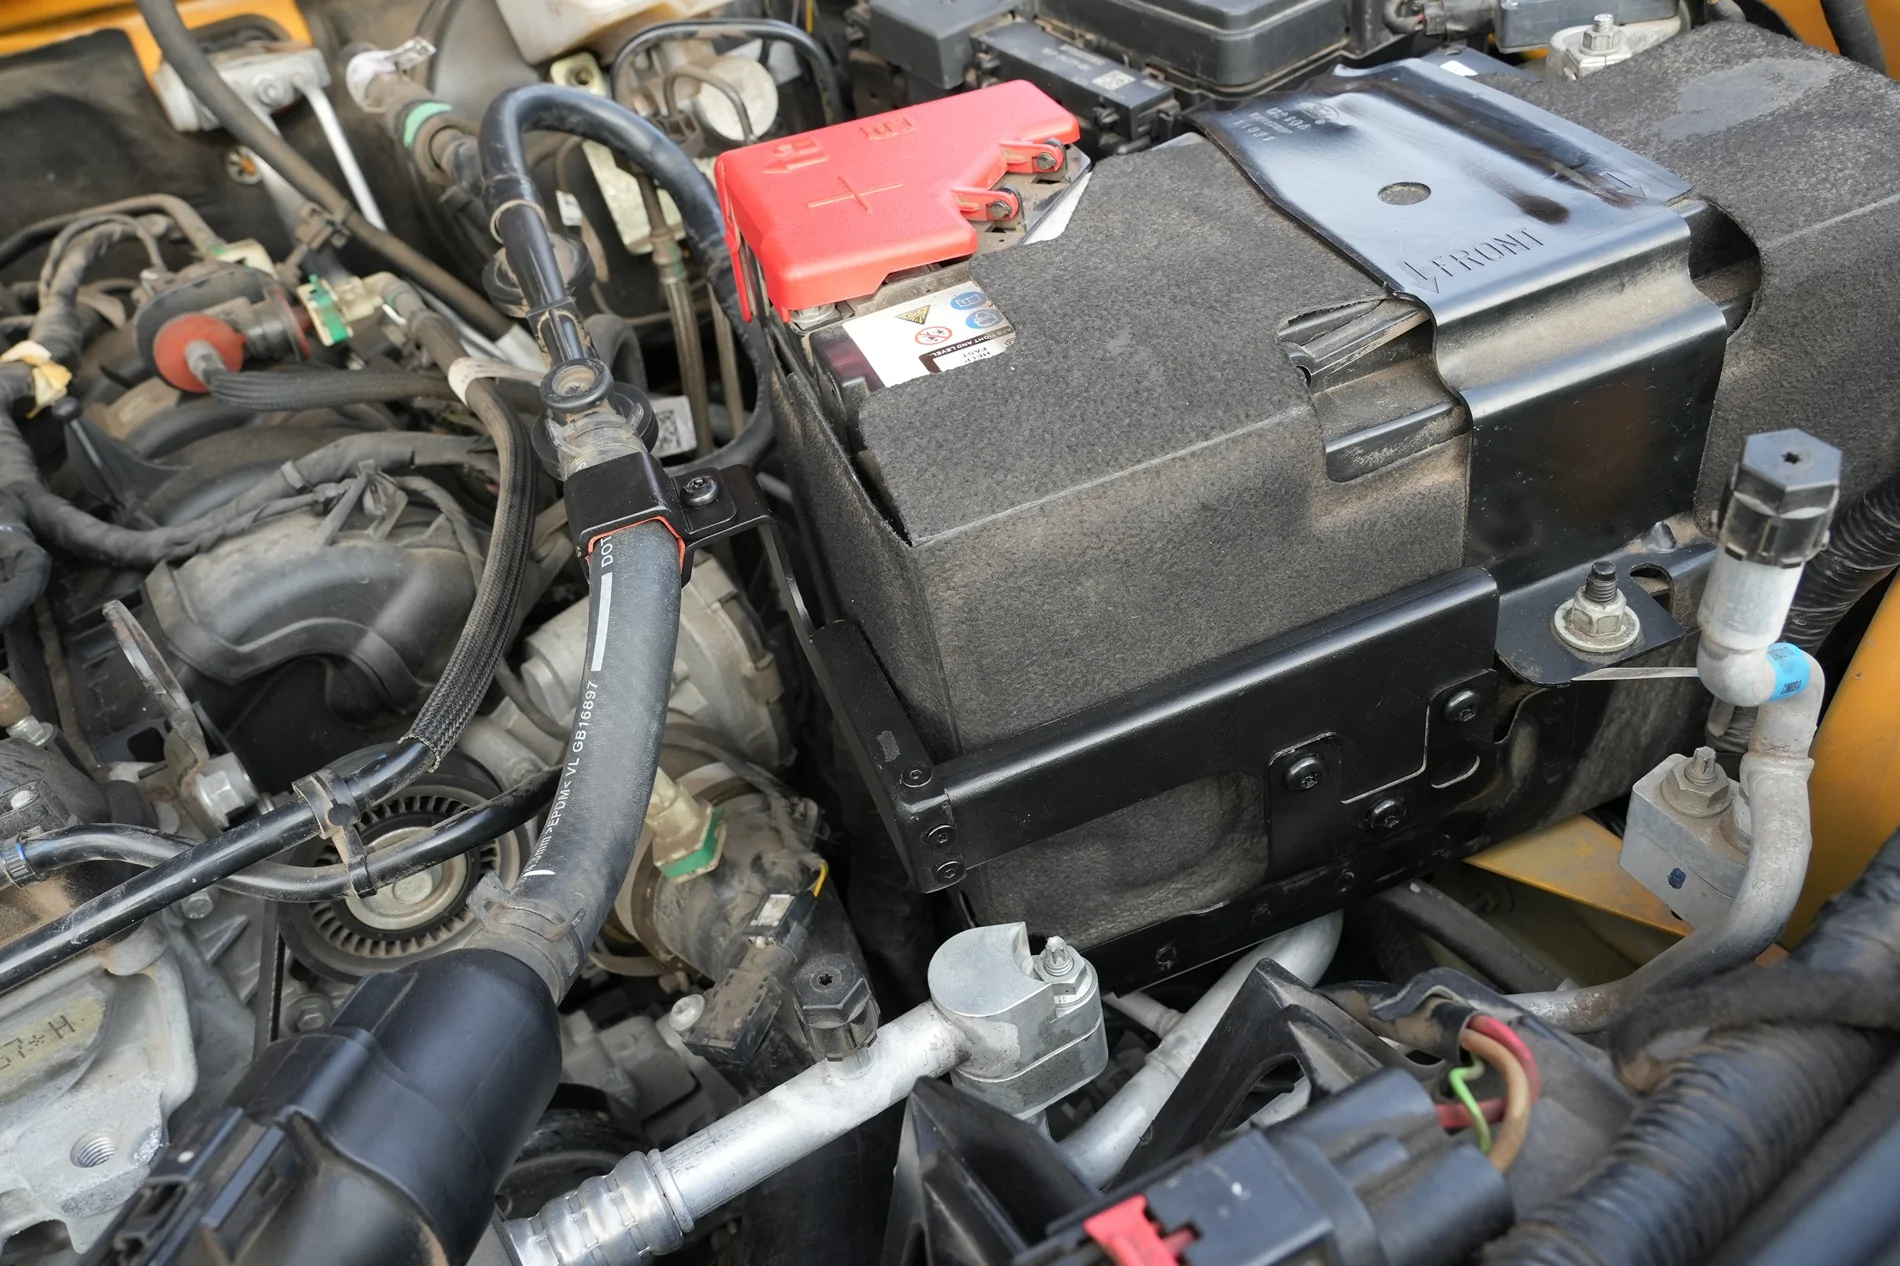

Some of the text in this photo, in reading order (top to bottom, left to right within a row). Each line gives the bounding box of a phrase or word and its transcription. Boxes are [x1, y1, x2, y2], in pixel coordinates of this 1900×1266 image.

[1432, 227, 1544, 277] FRONT
[956, 340, 973, 350] AND
[600, 535, 613, 568] DOT
[572, 681, 598, 753] GB16897
[565, 757, 580, 777] VL
